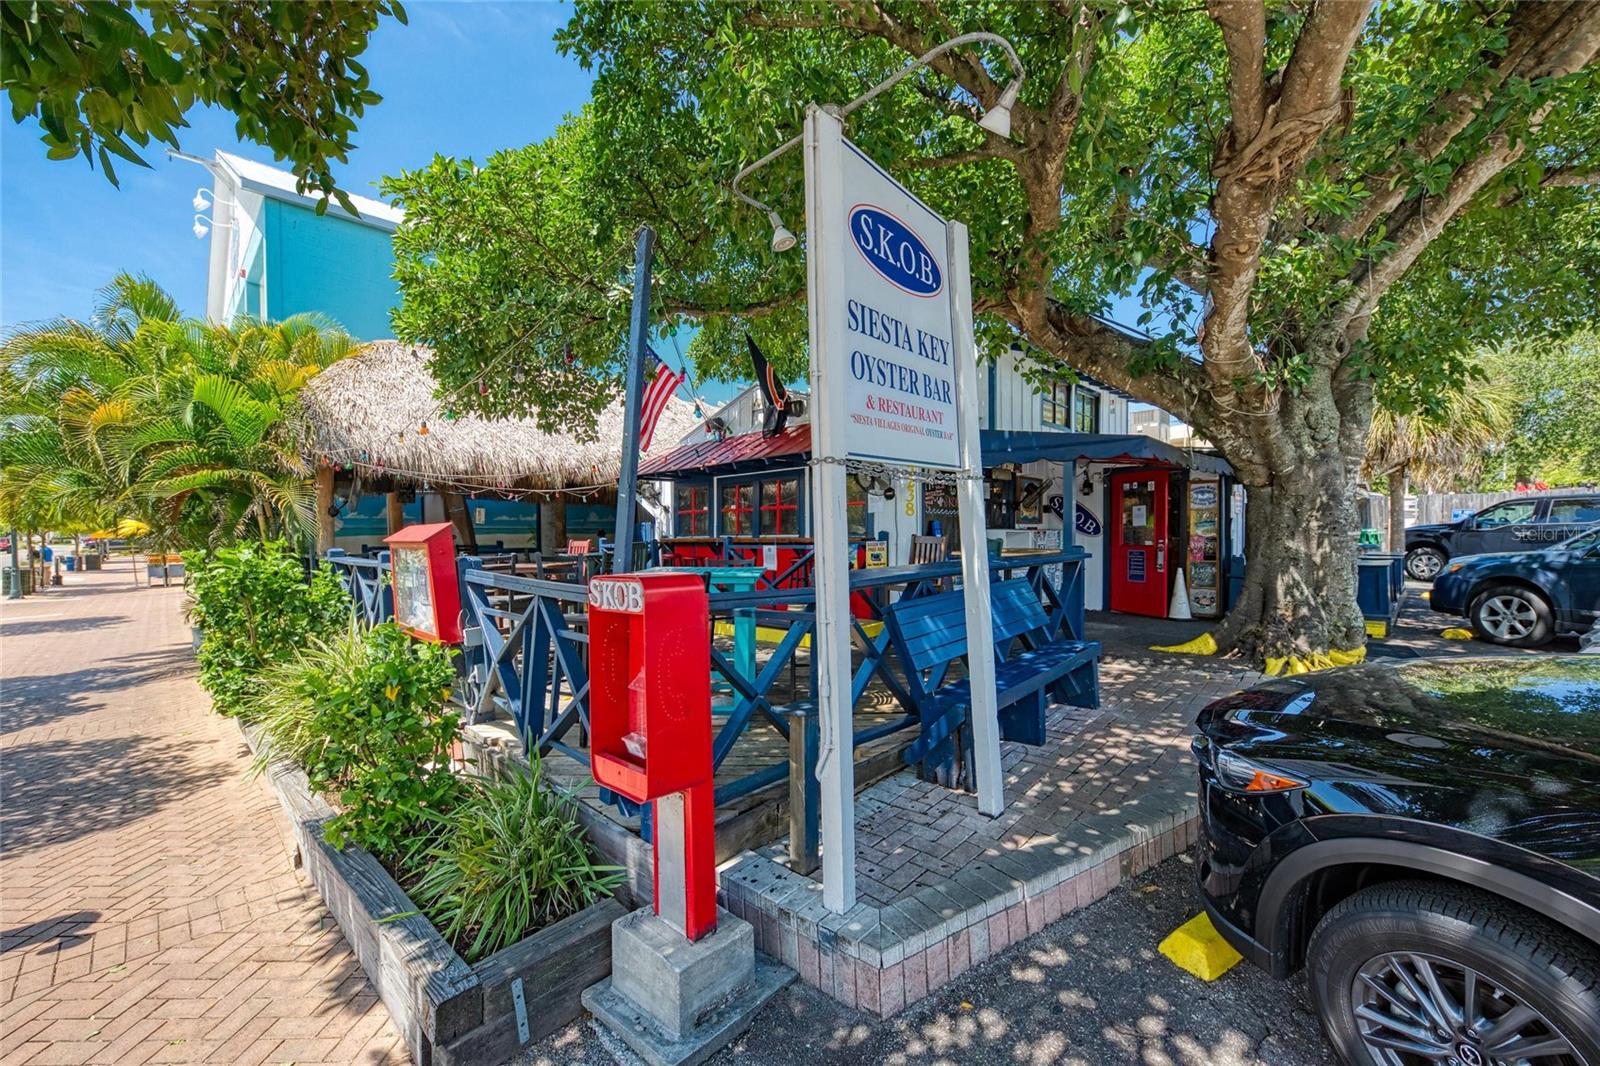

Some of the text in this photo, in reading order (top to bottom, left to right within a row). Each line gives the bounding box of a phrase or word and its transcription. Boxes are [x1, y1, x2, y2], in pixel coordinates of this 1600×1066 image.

[860, 213, 937, 289] S.K.O.B.
[847, 298, 950, 366] SIESTA KEY
[850, 350, 953, 405] OYSTER BAR
[866, 394, 945, 425] & RESTAURANT
[900, 422, 925, 436] ORIGINAL
[925, 428, 943, 439] OYSTER
[588, 579, 643, 613] SKOB
